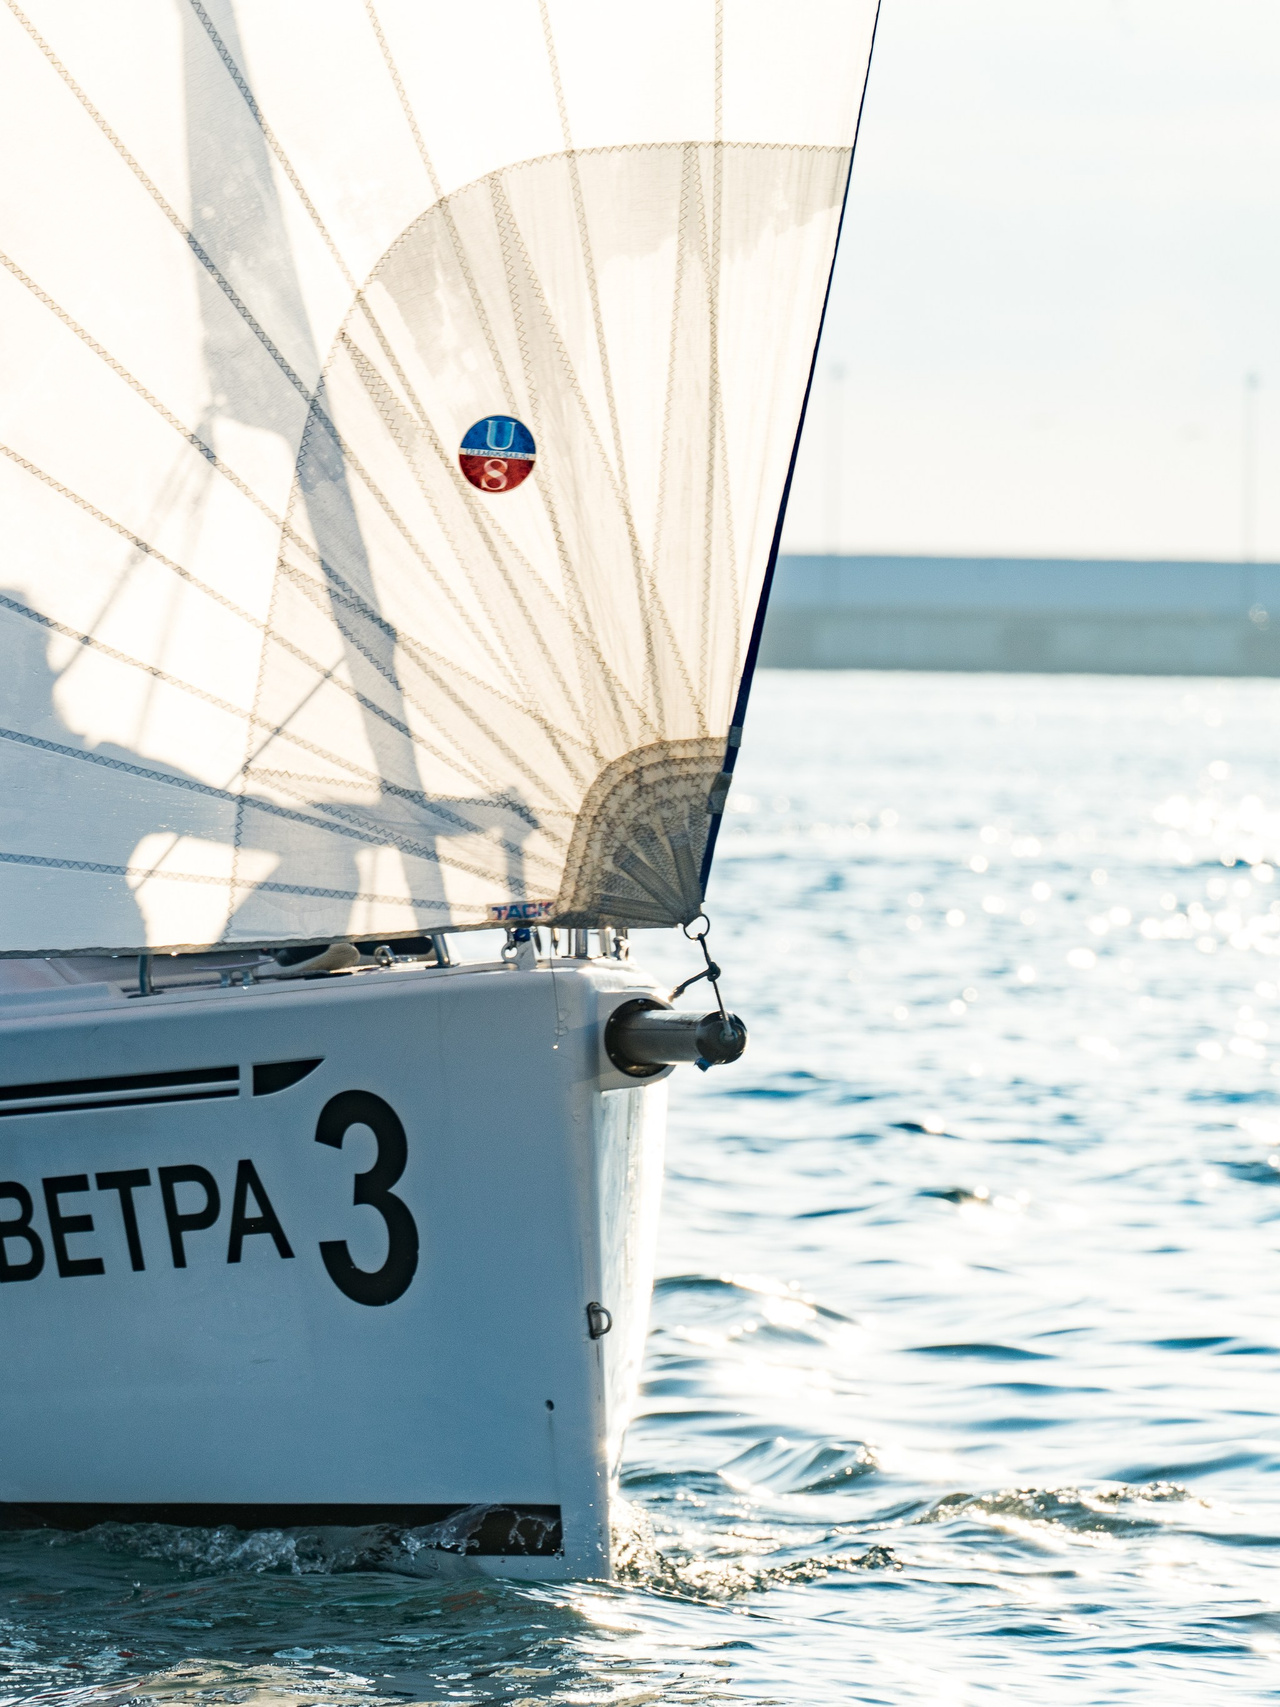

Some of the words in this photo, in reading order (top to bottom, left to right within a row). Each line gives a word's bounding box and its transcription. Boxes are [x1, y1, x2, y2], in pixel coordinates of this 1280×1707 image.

[485, 419, 517, 451] U
[491, 901, 555, 921] TACK
[313, 1088, 421, 1308] 3
